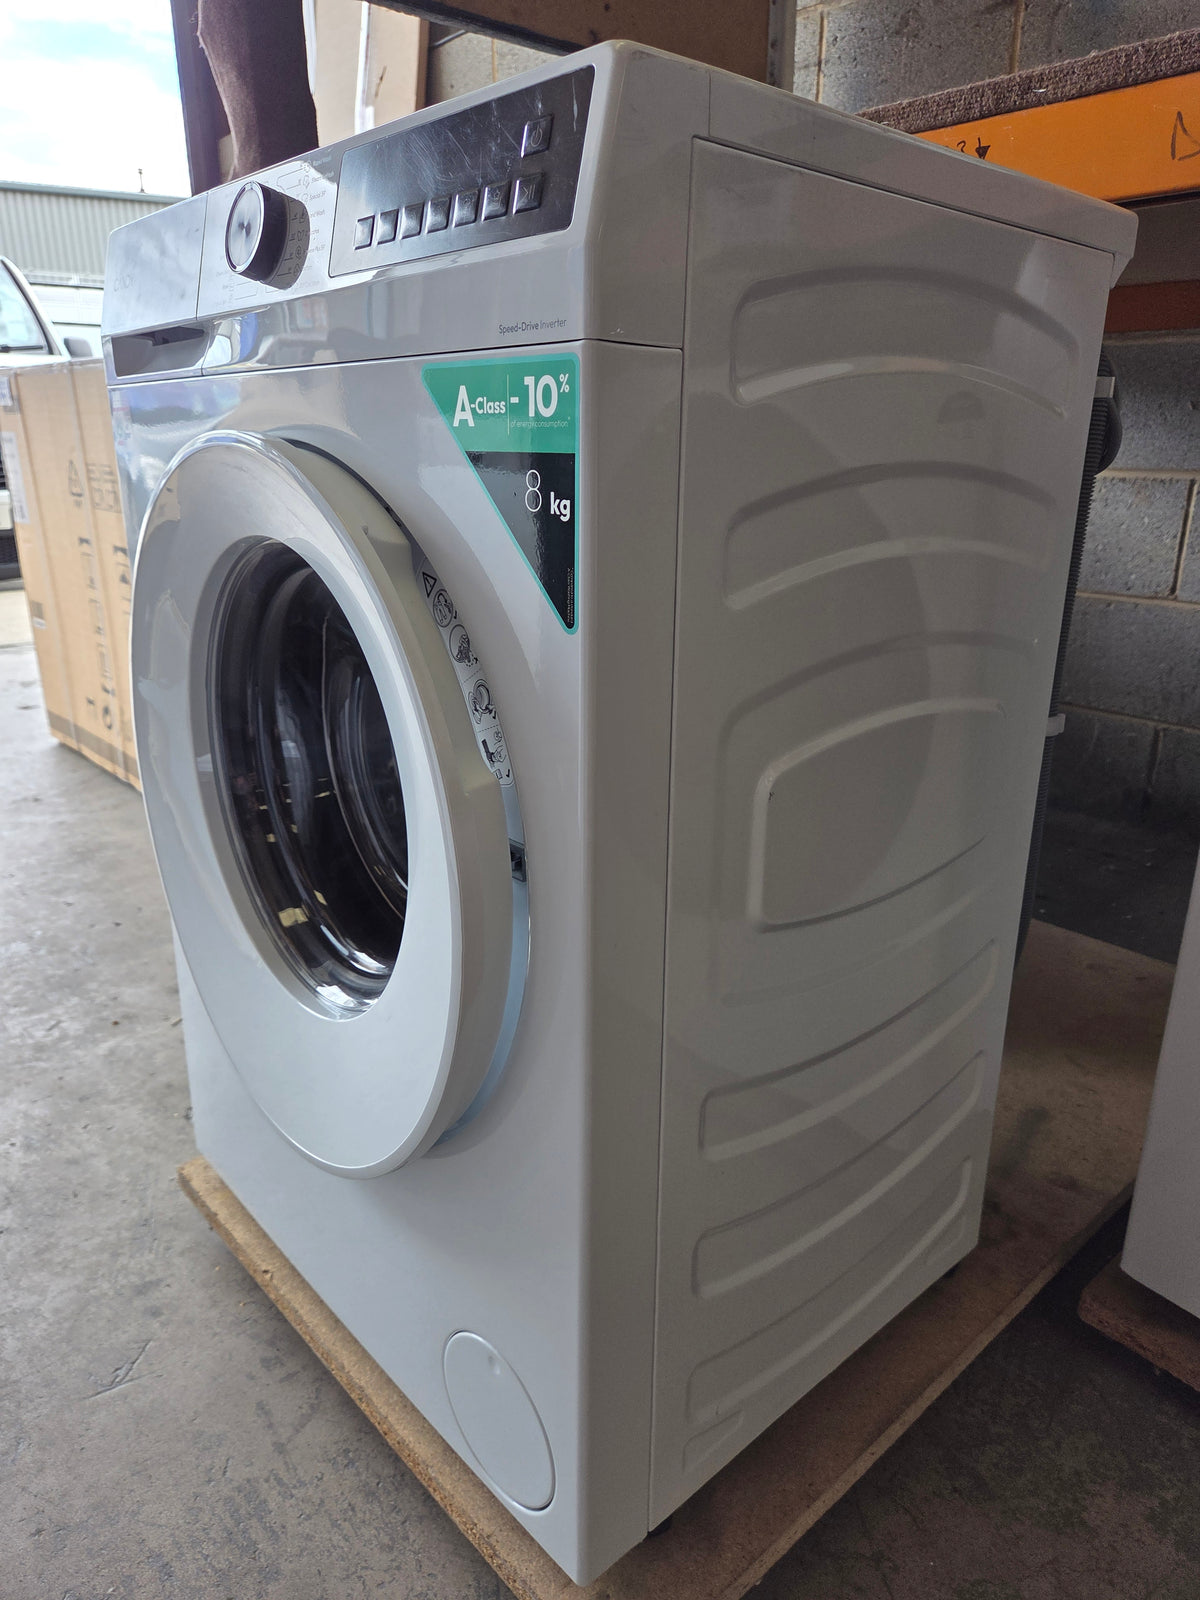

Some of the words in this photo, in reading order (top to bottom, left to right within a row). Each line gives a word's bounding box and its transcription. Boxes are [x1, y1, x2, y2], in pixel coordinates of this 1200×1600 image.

[498, 321, 539, 336] Speed-Drive
[540, 318, 567, 330] Inverter
[524, 469, 542, 512] 8
[550, 492, 571, 522] kg
